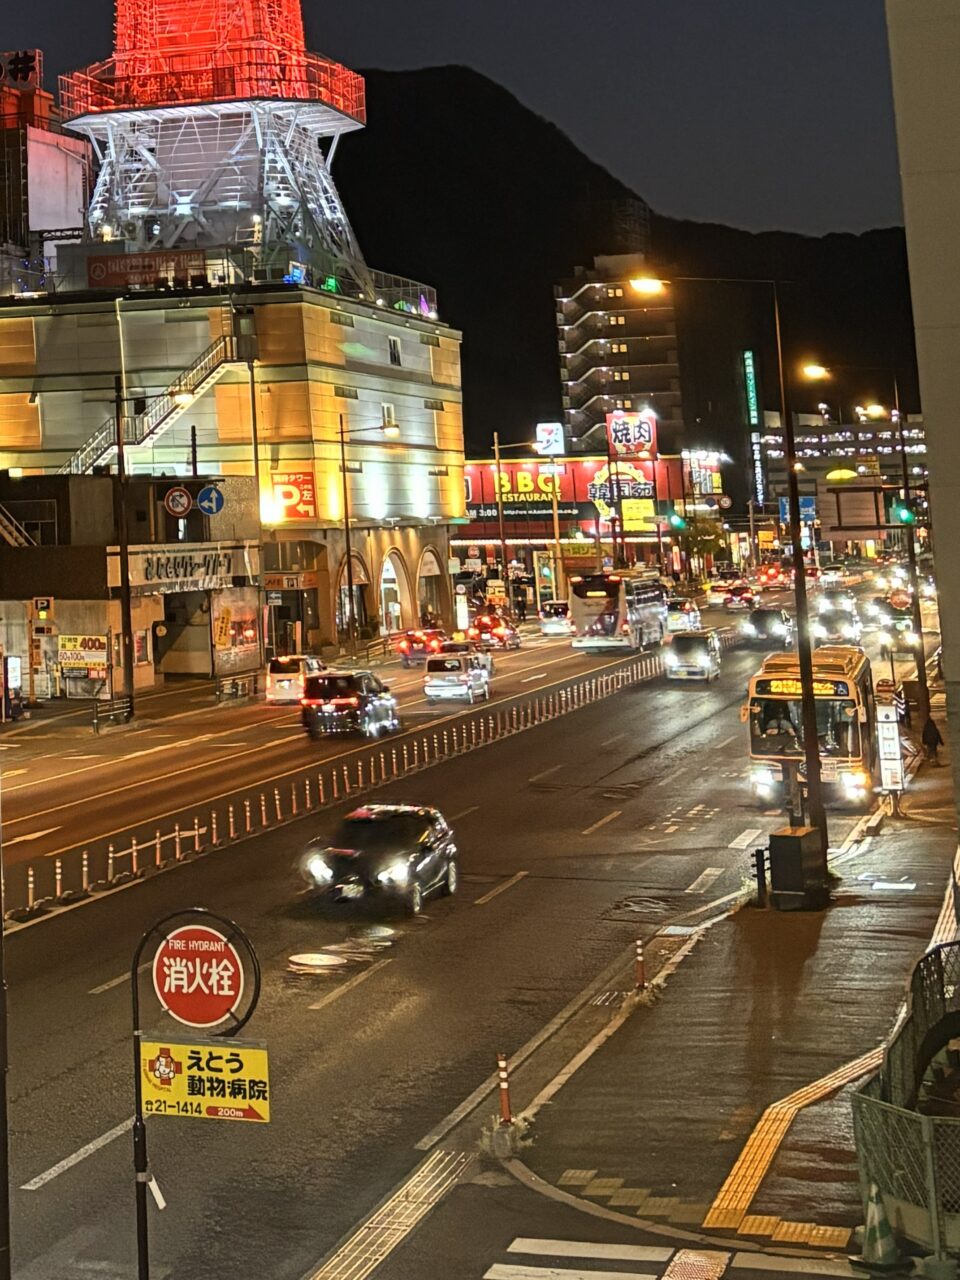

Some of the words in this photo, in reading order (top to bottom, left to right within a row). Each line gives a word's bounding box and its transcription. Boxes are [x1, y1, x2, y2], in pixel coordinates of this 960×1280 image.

[612, 420, 651, 443] 焼肉
[494, 472, 560, 493] BBQ
[302, 490, 313, 500] 左
[38, 600, 48, 609] P
[168, 939, 186, 950] FIRE
[188, 940, 225, 952] HYDRANT
[163, 956, 235, 996] 消火栓
[187, 1050, 244, 1073] えとう
[187, 1075, 268, 1101] 動物病院
[155, 1099, 202, 1115] 21-1414
[217, 1107, 244, 1118] 200m
